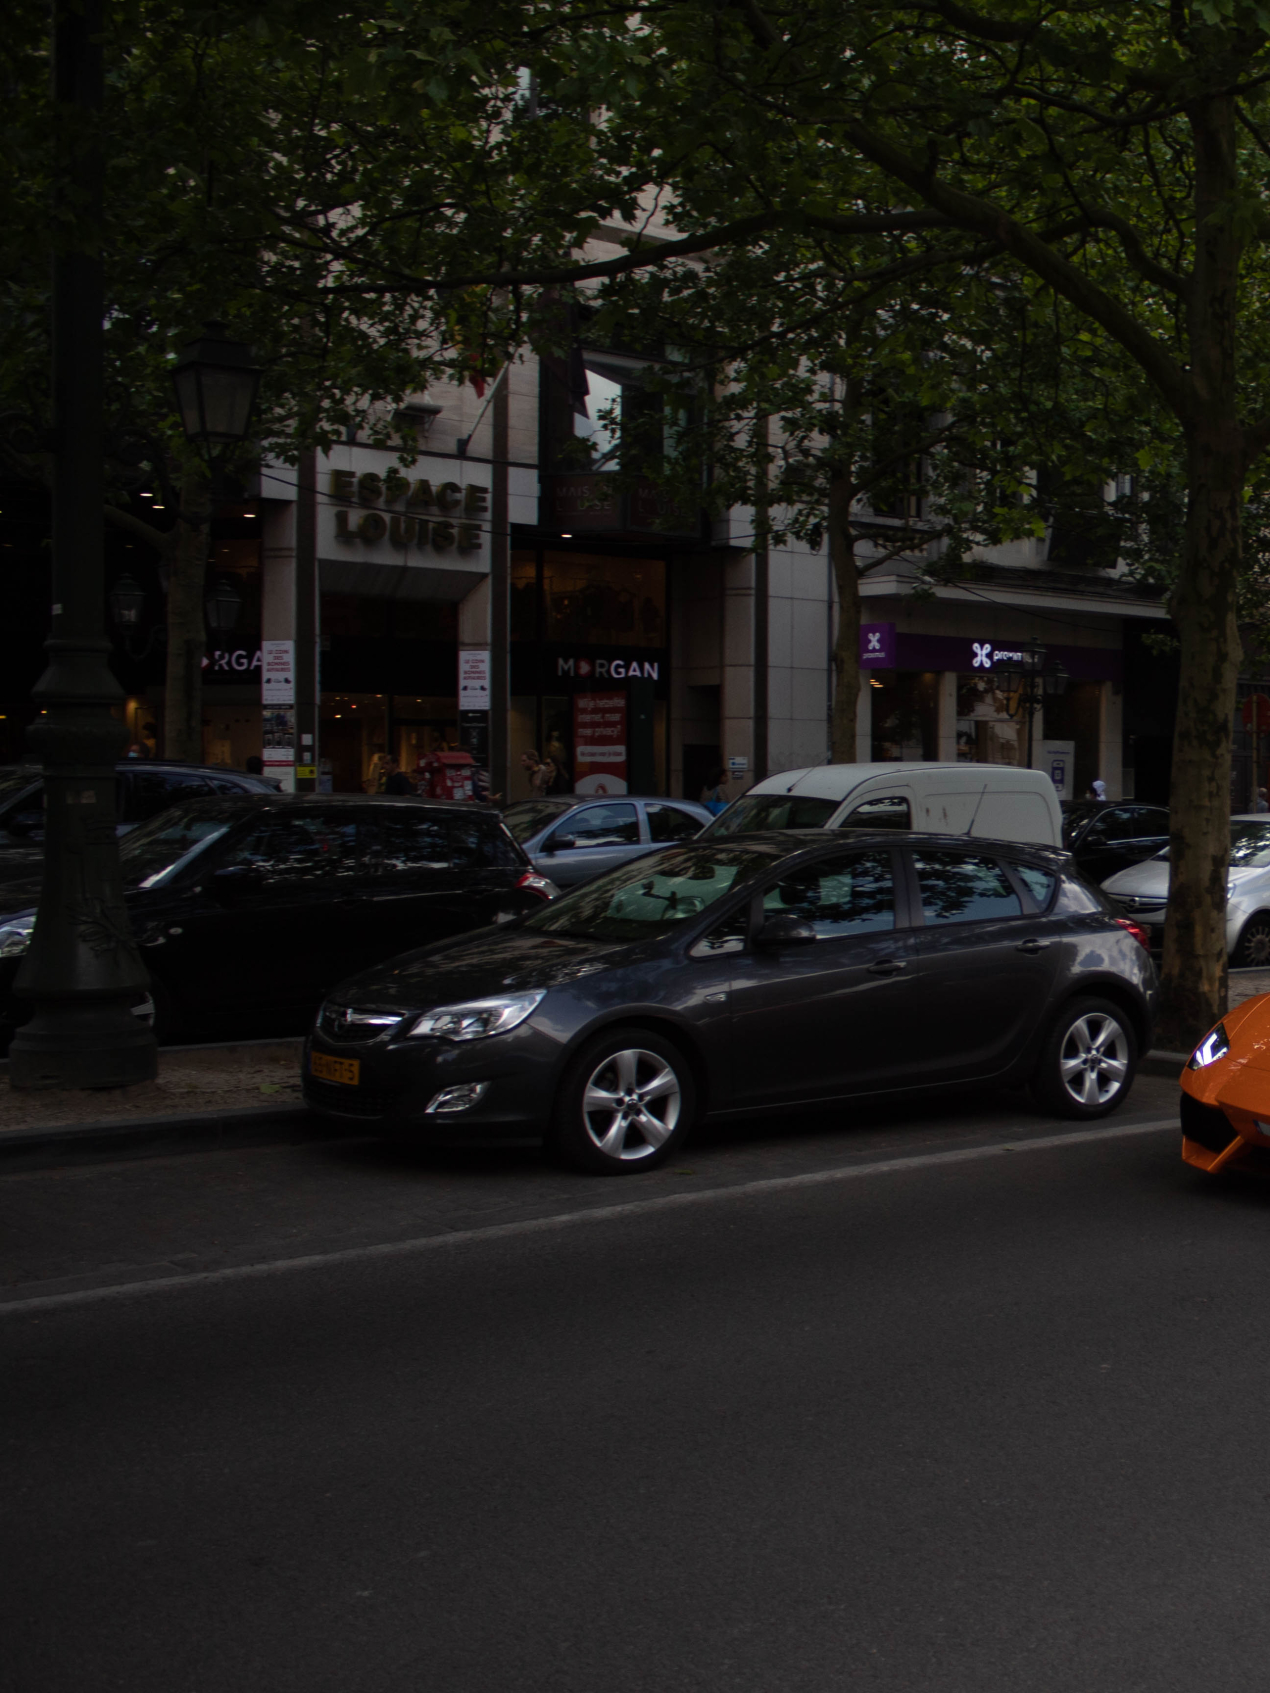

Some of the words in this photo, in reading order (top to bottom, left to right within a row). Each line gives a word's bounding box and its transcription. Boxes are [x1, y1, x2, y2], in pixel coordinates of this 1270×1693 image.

[330, 469, 489, 513] ESPACE
[335, 510, 482, 551] LOUISE
[556, 657, 659, 681] MORGAN
